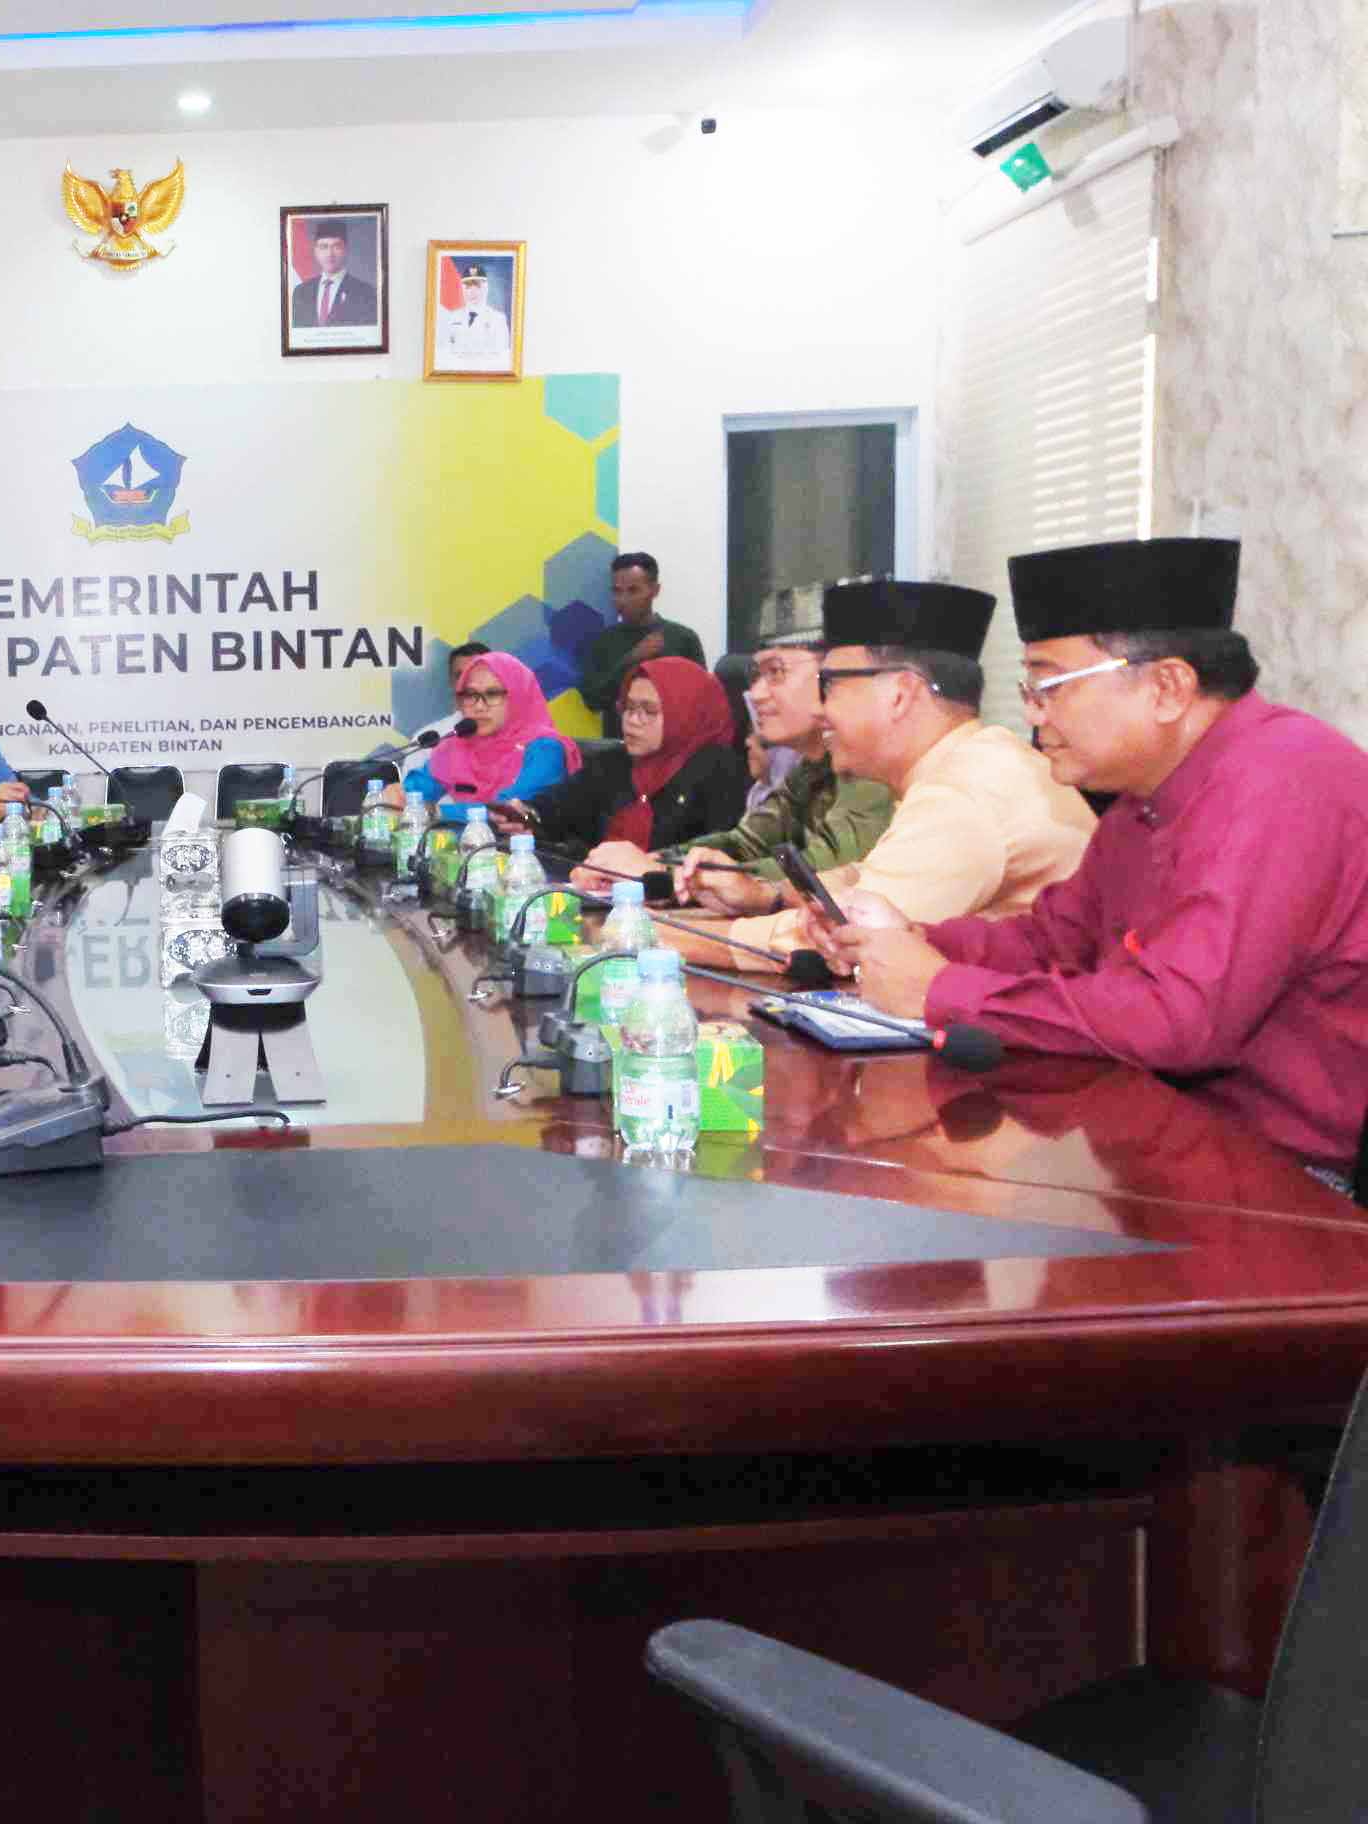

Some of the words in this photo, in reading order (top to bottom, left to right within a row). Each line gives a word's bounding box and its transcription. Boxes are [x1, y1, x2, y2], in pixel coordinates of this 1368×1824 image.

[211, 625, 423, 672] BINTAN
[89, 719, 194, 735] PENELITIAN,
[200, 718, 237, 732] DAN
[243, 713, 392, 731] PENGEMBANGAN
[48, 739, 152, 756] KABUPATEN
[159, 737, 223, 753] BINTAN
